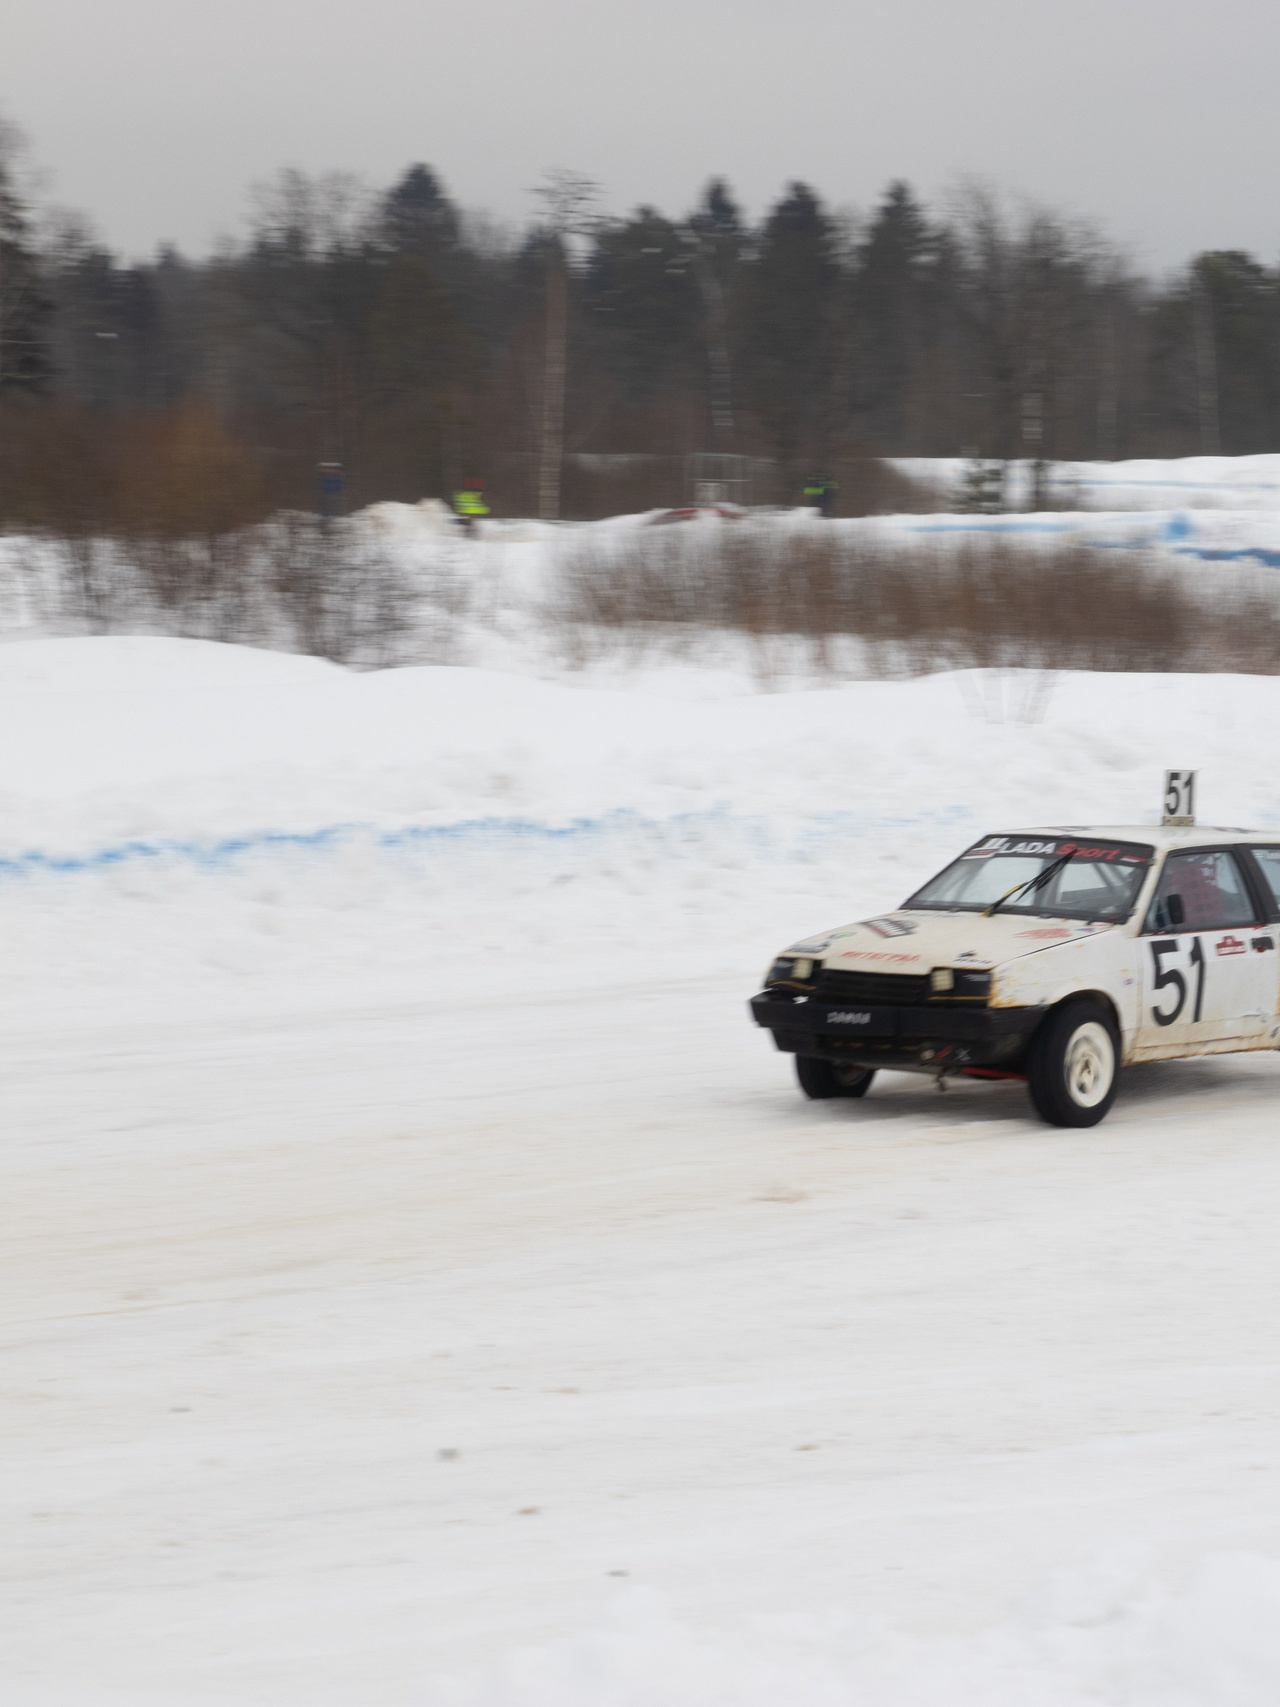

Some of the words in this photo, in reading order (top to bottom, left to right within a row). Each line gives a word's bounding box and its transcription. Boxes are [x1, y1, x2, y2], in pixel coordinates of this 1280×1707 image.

[1165, 771, 1196, 816] 51
[998, 842, 1057, 855] LADA
[1055, 843, 1121, 861] Sport
[1150, 935, 1206, 1027] 51
